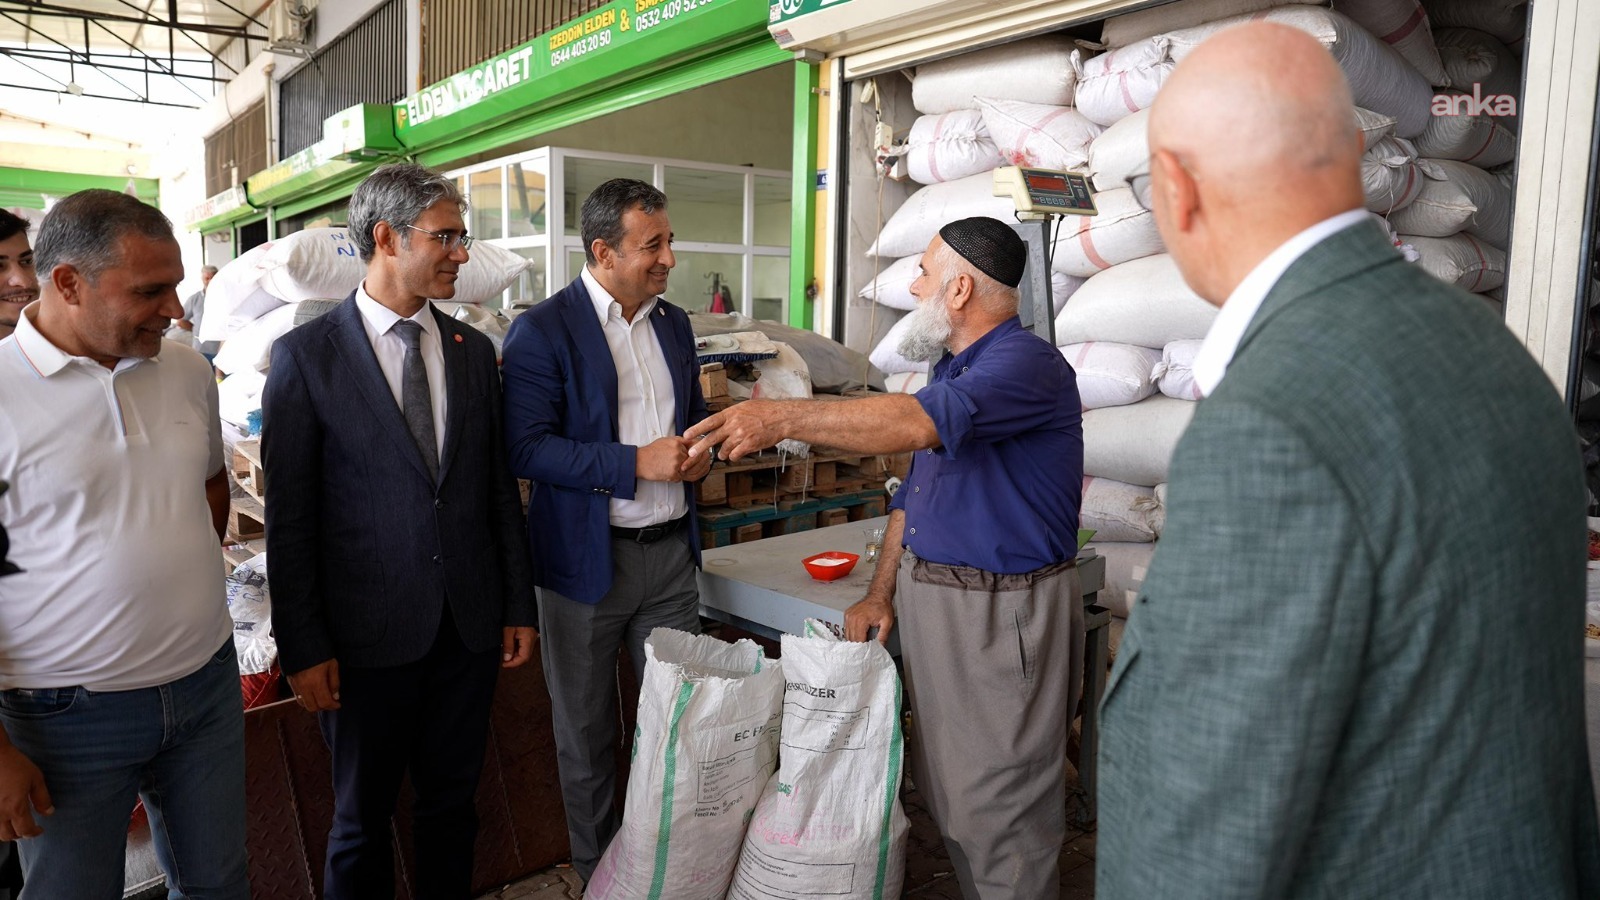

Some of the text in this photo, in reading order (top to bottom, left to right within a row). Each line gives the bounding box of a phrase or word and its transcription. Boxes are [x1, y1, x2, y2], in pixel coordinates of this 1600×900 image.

[585, 8, 615, 34] ELDEN
[619, 8, 631, 32] &
[636, 8, 660, 32] 0532
[662, 0, 681, 20] 409
[551, 29, 611, 66] 0544 403 20 50
[407, 82, 453, 127] ELDEN
[734, 729, 750, 742] EC
